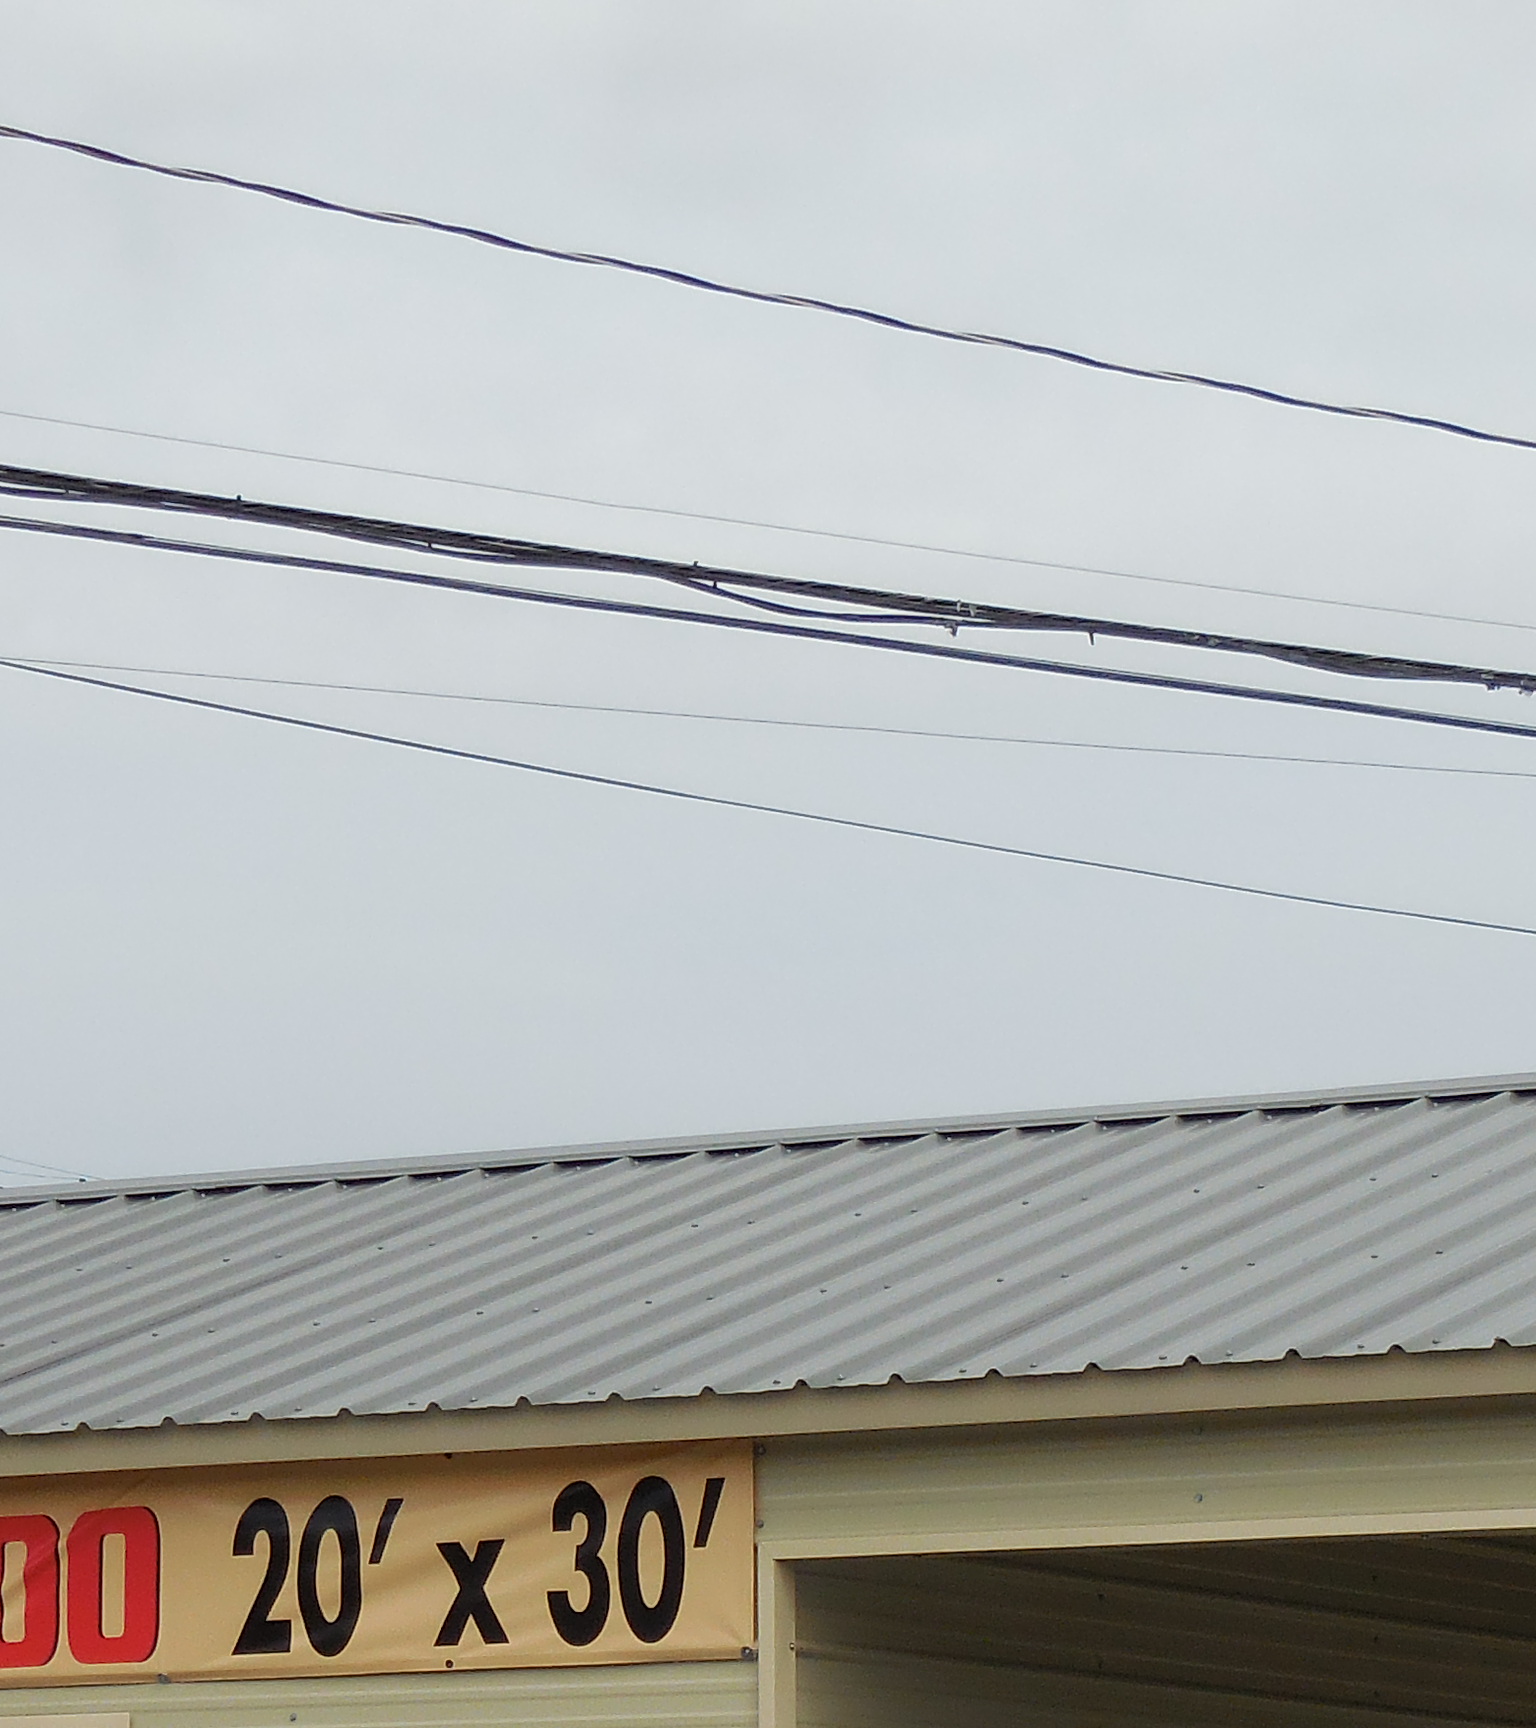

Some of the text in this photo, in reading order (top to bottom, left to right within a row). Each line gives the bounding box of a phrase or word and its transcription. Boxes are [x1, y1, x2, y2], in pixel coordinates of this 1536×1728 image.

[231, 1494, 404, 1658] 20'
[433, 1538, 509, 1647] x
[546, 1475, 726, 1647] 30'
